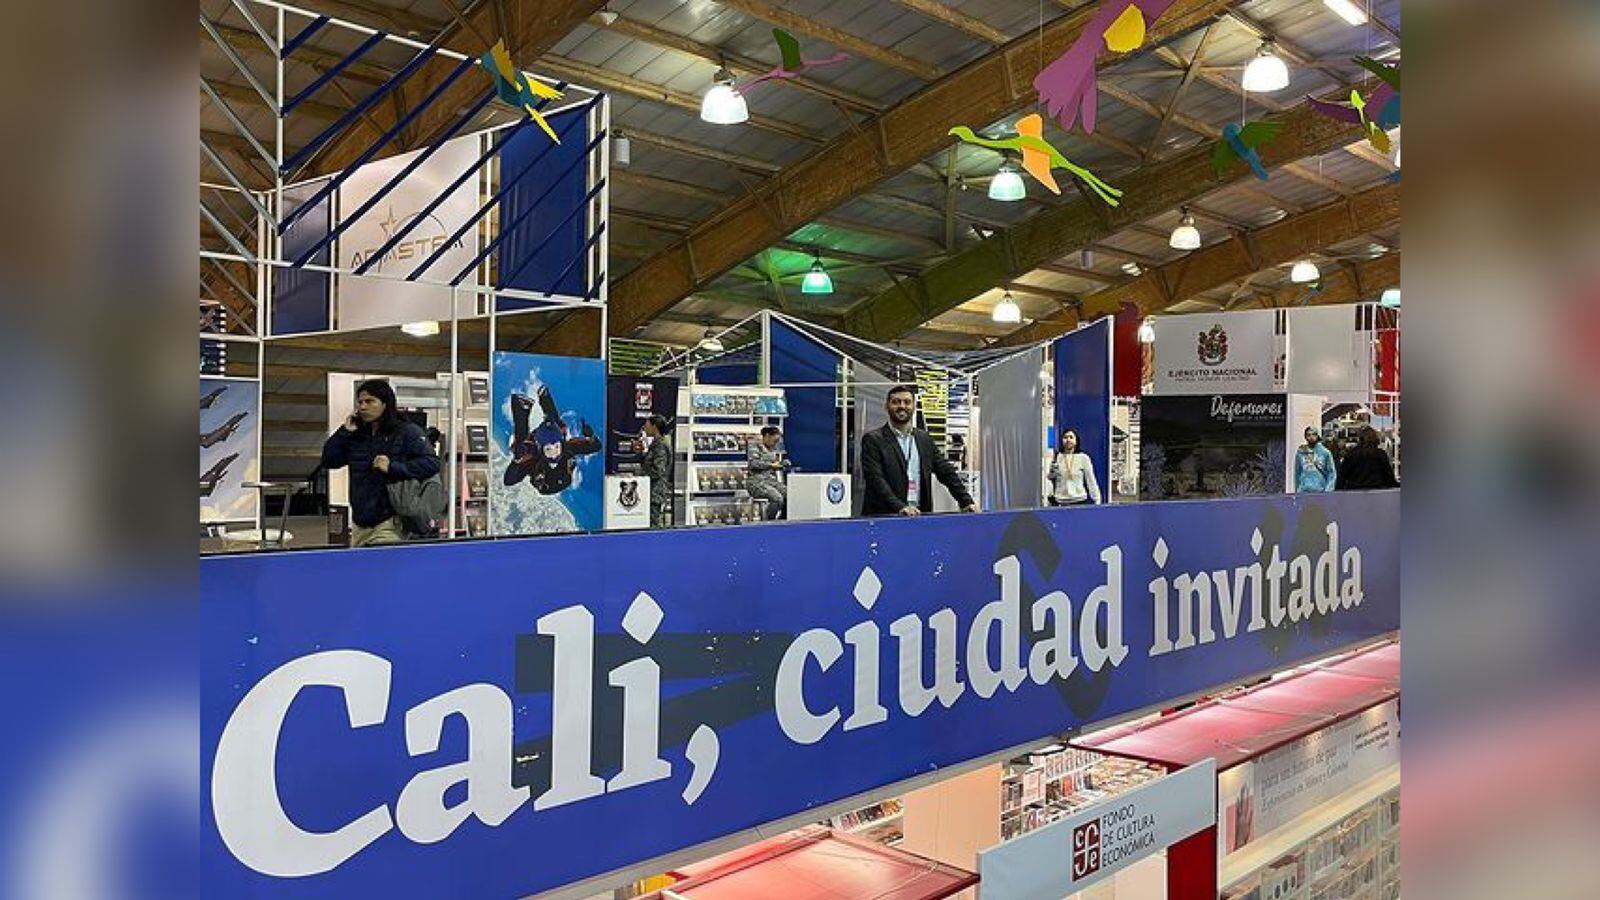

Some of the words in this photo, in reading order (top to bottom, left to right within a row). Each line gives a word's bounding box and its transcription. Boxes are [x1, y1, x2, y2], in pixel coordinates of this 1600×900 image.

[1212, 368, 1257, 376] NACIONAL
[1210, 395, 1283, 423] Defensores
[211, 590, 720, 877] Cali,
[775, 544, 1129, 745] ciudad
[1148, 521, 1364, 658] invitada
[1103, 804, 1134, 828] FONDO
[1103, 831, 1114, 848] DE
[1117, 814, 1155, 840] CULTURA
